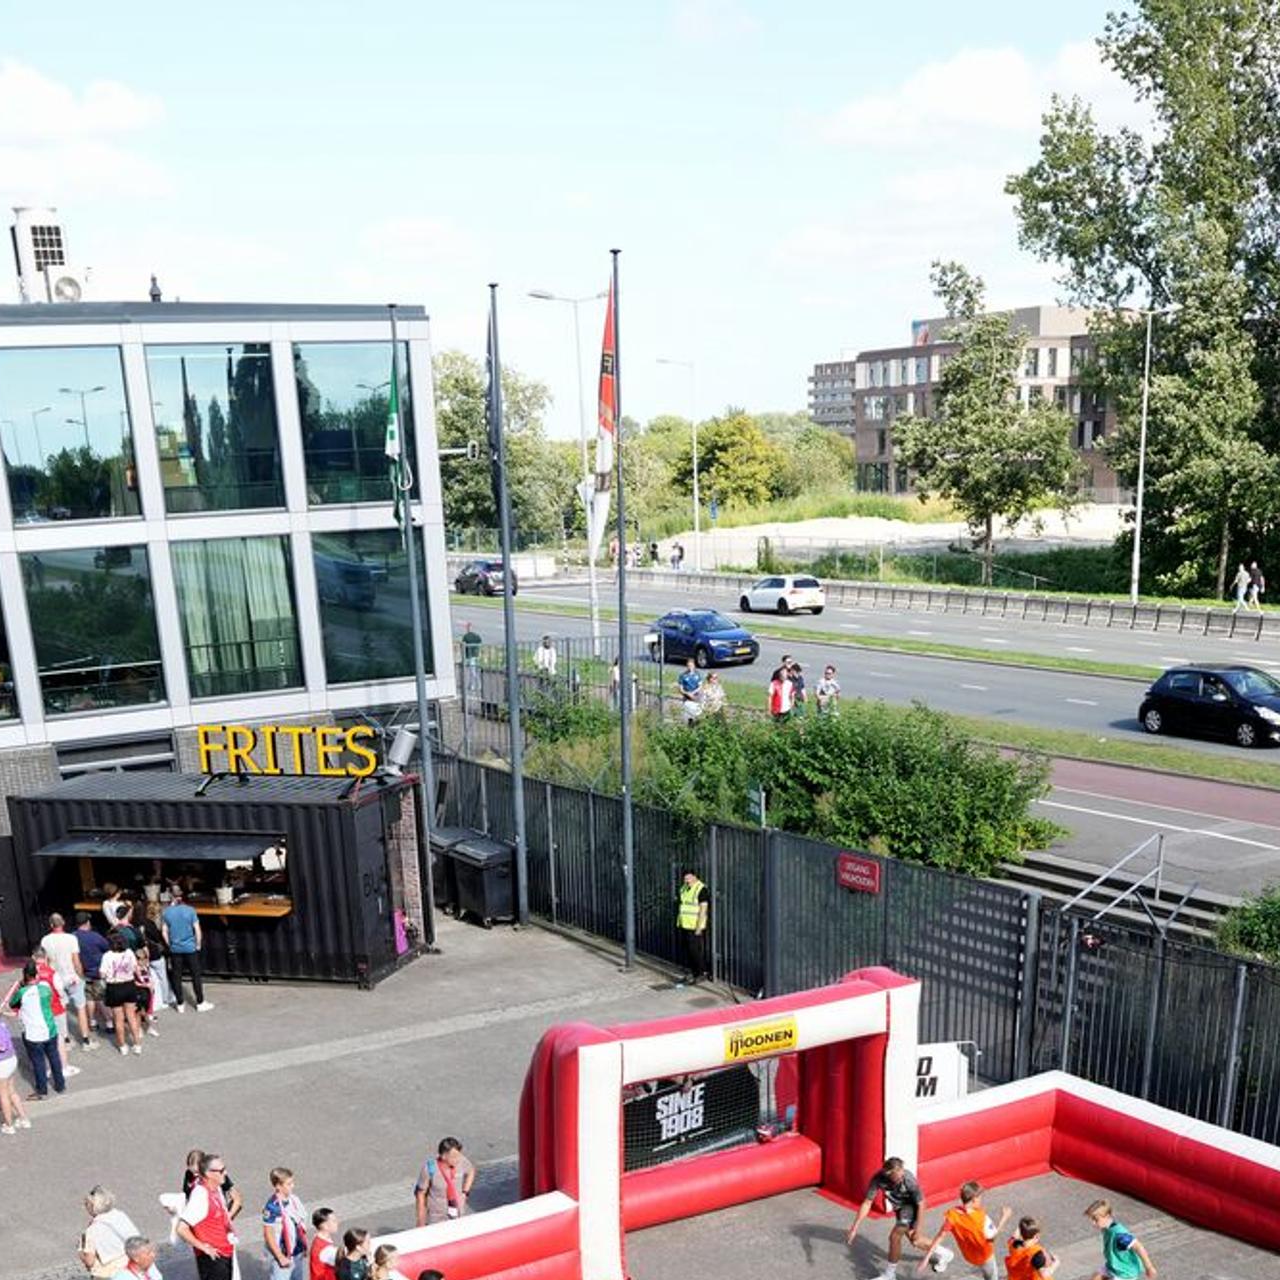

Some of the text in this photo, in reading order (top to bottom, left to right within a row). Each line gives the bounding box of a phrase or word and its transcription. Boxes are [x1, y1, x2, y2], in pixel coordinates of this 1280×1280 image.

[197, 724, 378, 777] FRITES
[655, 1082, 706, 1121] SINCE
[660, 1105, 705, 1141] 1908
